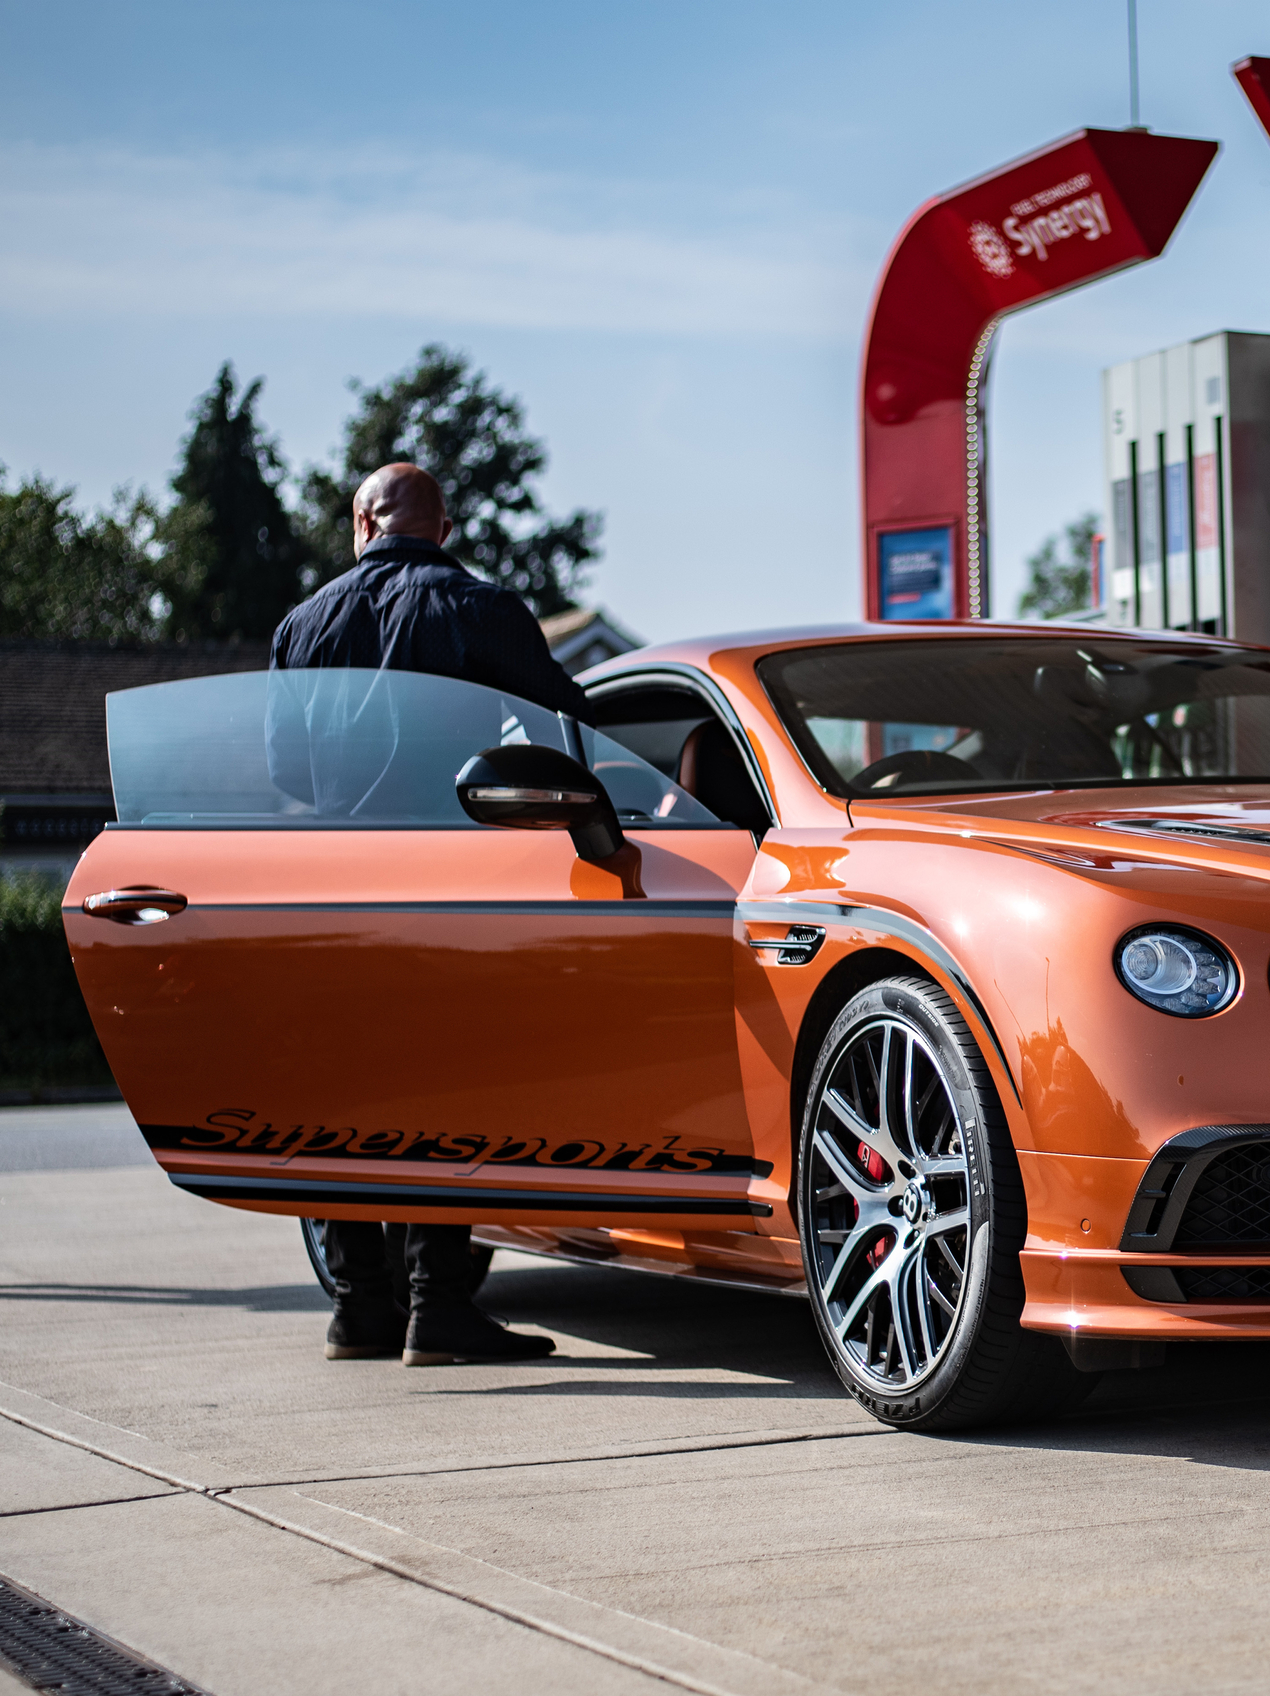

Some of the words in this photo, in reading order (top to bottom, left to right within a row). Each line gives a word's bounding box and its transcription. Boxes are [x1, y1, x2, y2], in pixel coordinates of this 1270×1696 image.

[1002, 192, 1112, 262] Synergy
[918, 1003, 940, 1028] OUTSIDE
[180, 1107, 727, 1177] Supersports
